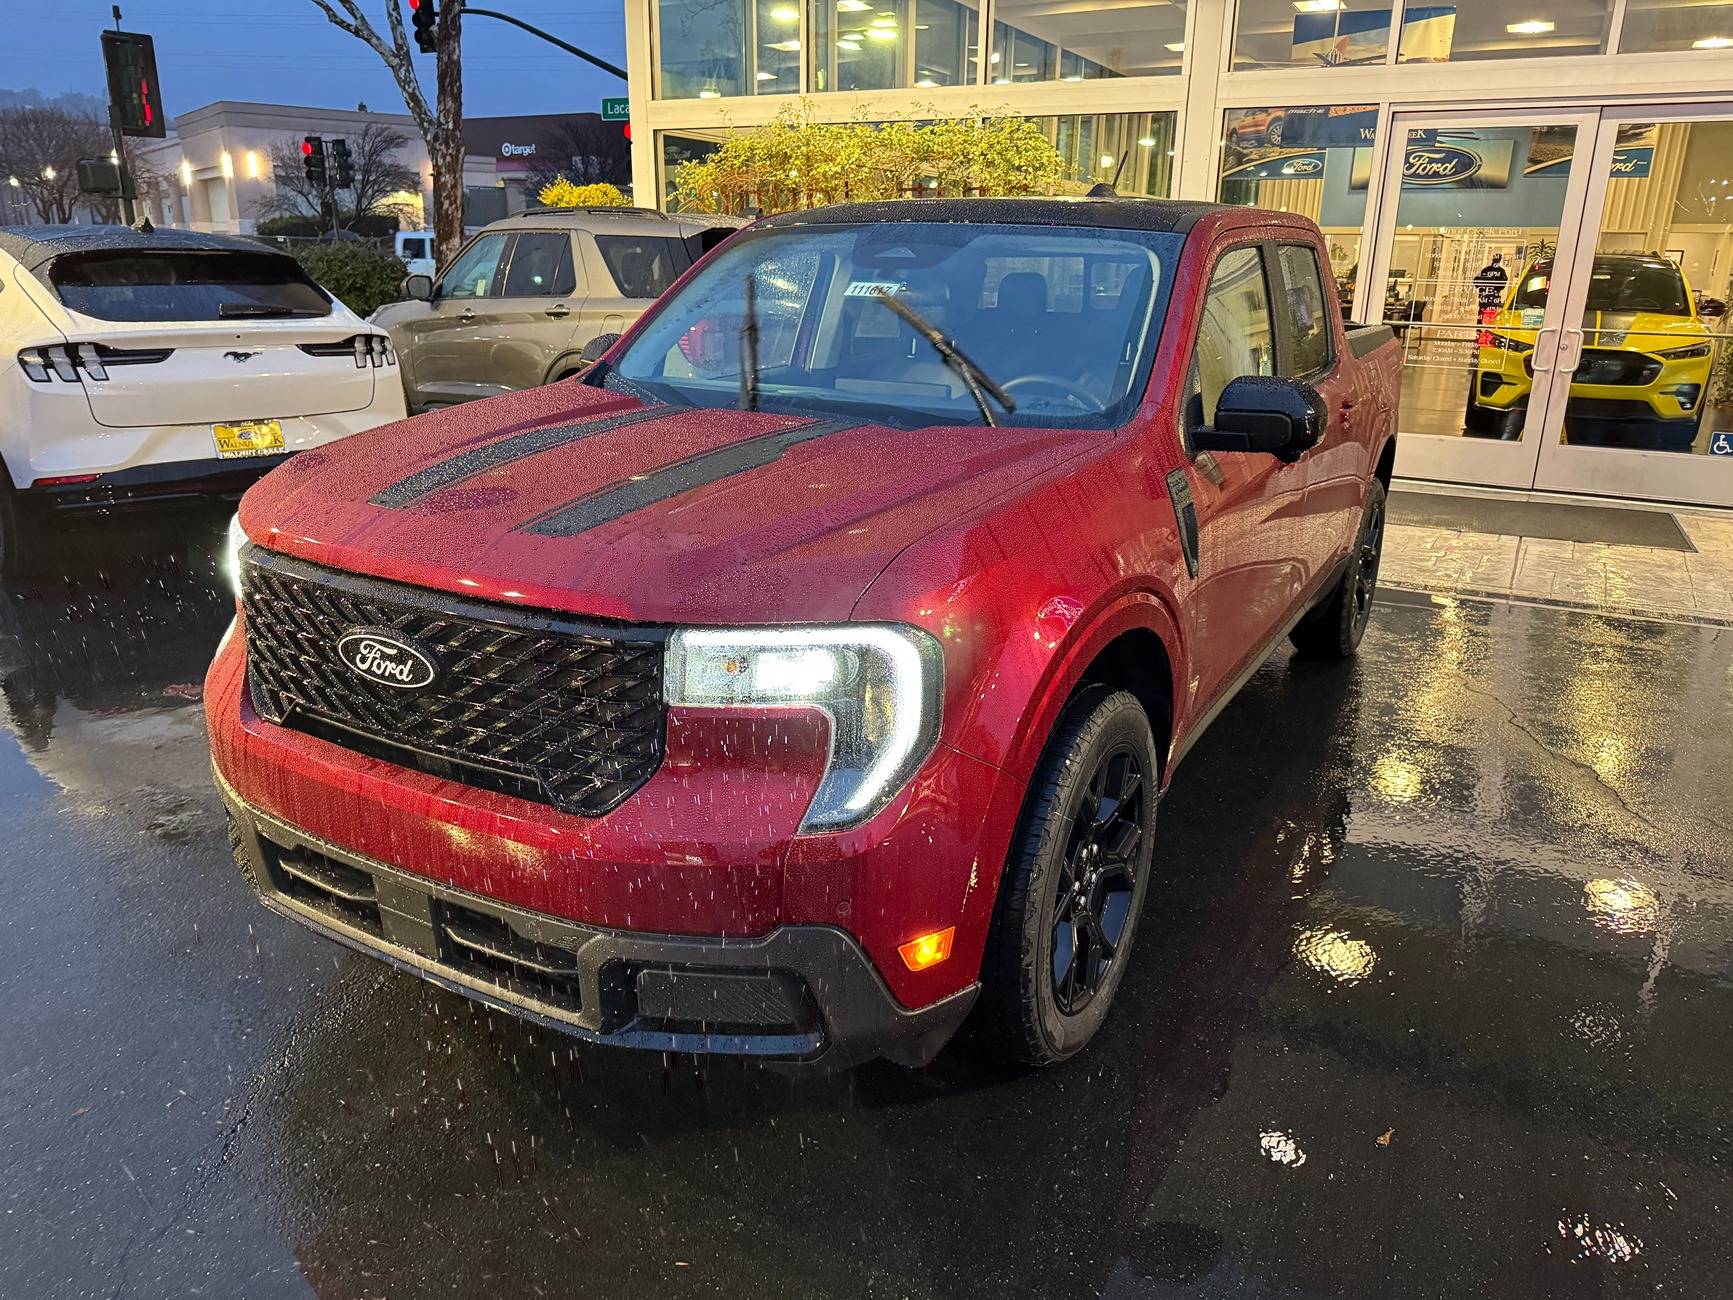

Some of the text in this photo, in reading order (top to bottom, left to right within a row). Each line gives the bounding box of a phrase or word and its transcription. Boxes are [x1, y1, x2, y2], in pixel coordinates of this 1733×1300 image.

[511, 143, 536, 156] target
[1290, 159, 1316, 173] Ford
[1404, 152, 1459, 175] Ford
[1430, 227, 1463, 235] Wlnut
[356, 641, 413, 682] Ford
